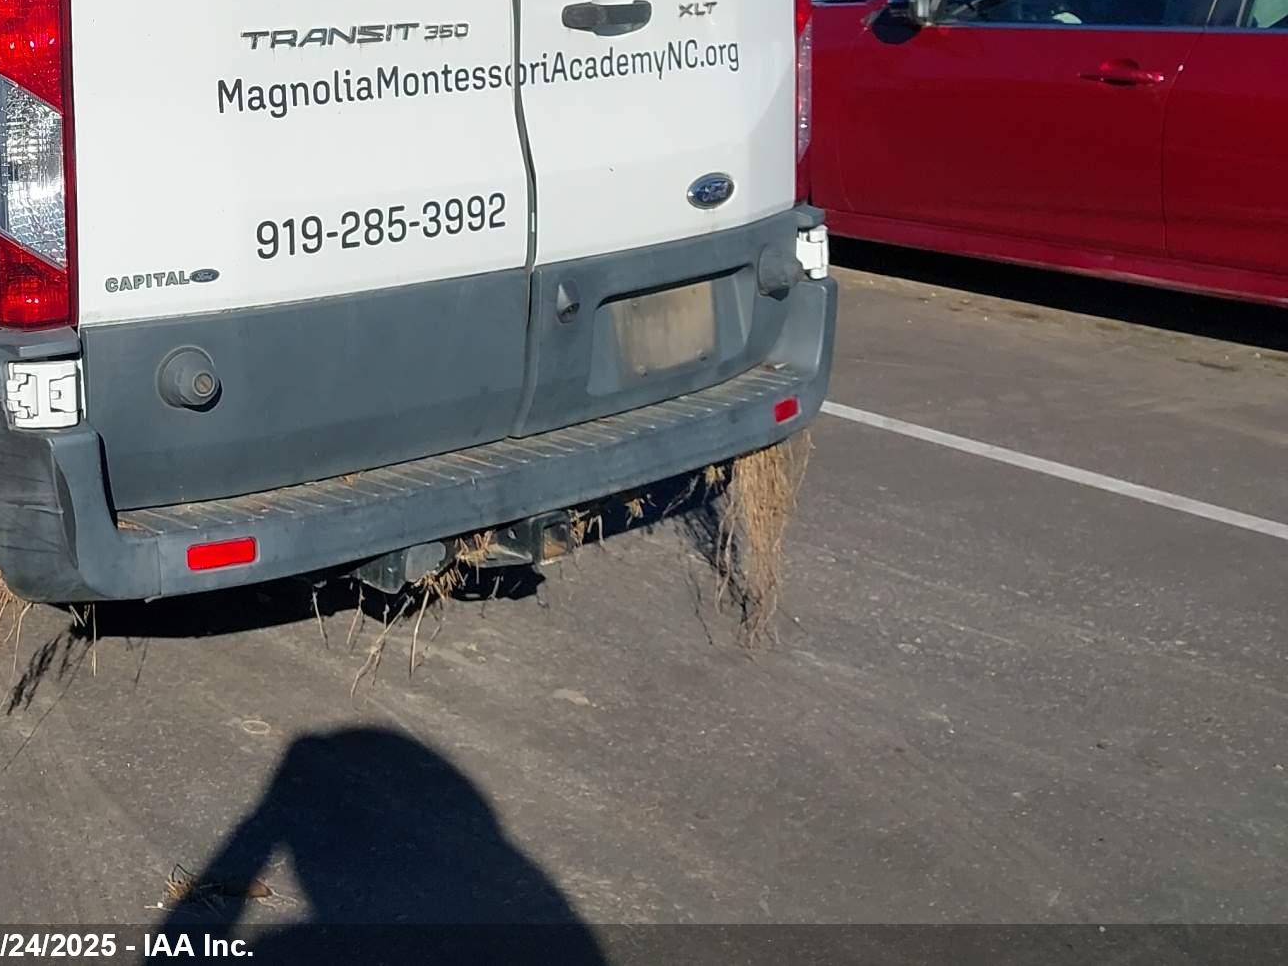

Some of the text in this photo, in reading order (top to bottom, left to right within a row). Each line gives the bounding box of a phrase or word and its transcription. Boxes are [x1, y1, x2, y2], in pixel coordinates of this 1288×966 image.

[678, 1, 718, 17] XLT
[240, 22, 469, 50] TRANSIT 350
[217, 39, 740, 118] MagnoliaMontessoriAcademyNC.org
[257, 192, 507, 259] 919-285-3992
[105, 270, 190, 293] CAPITAL
